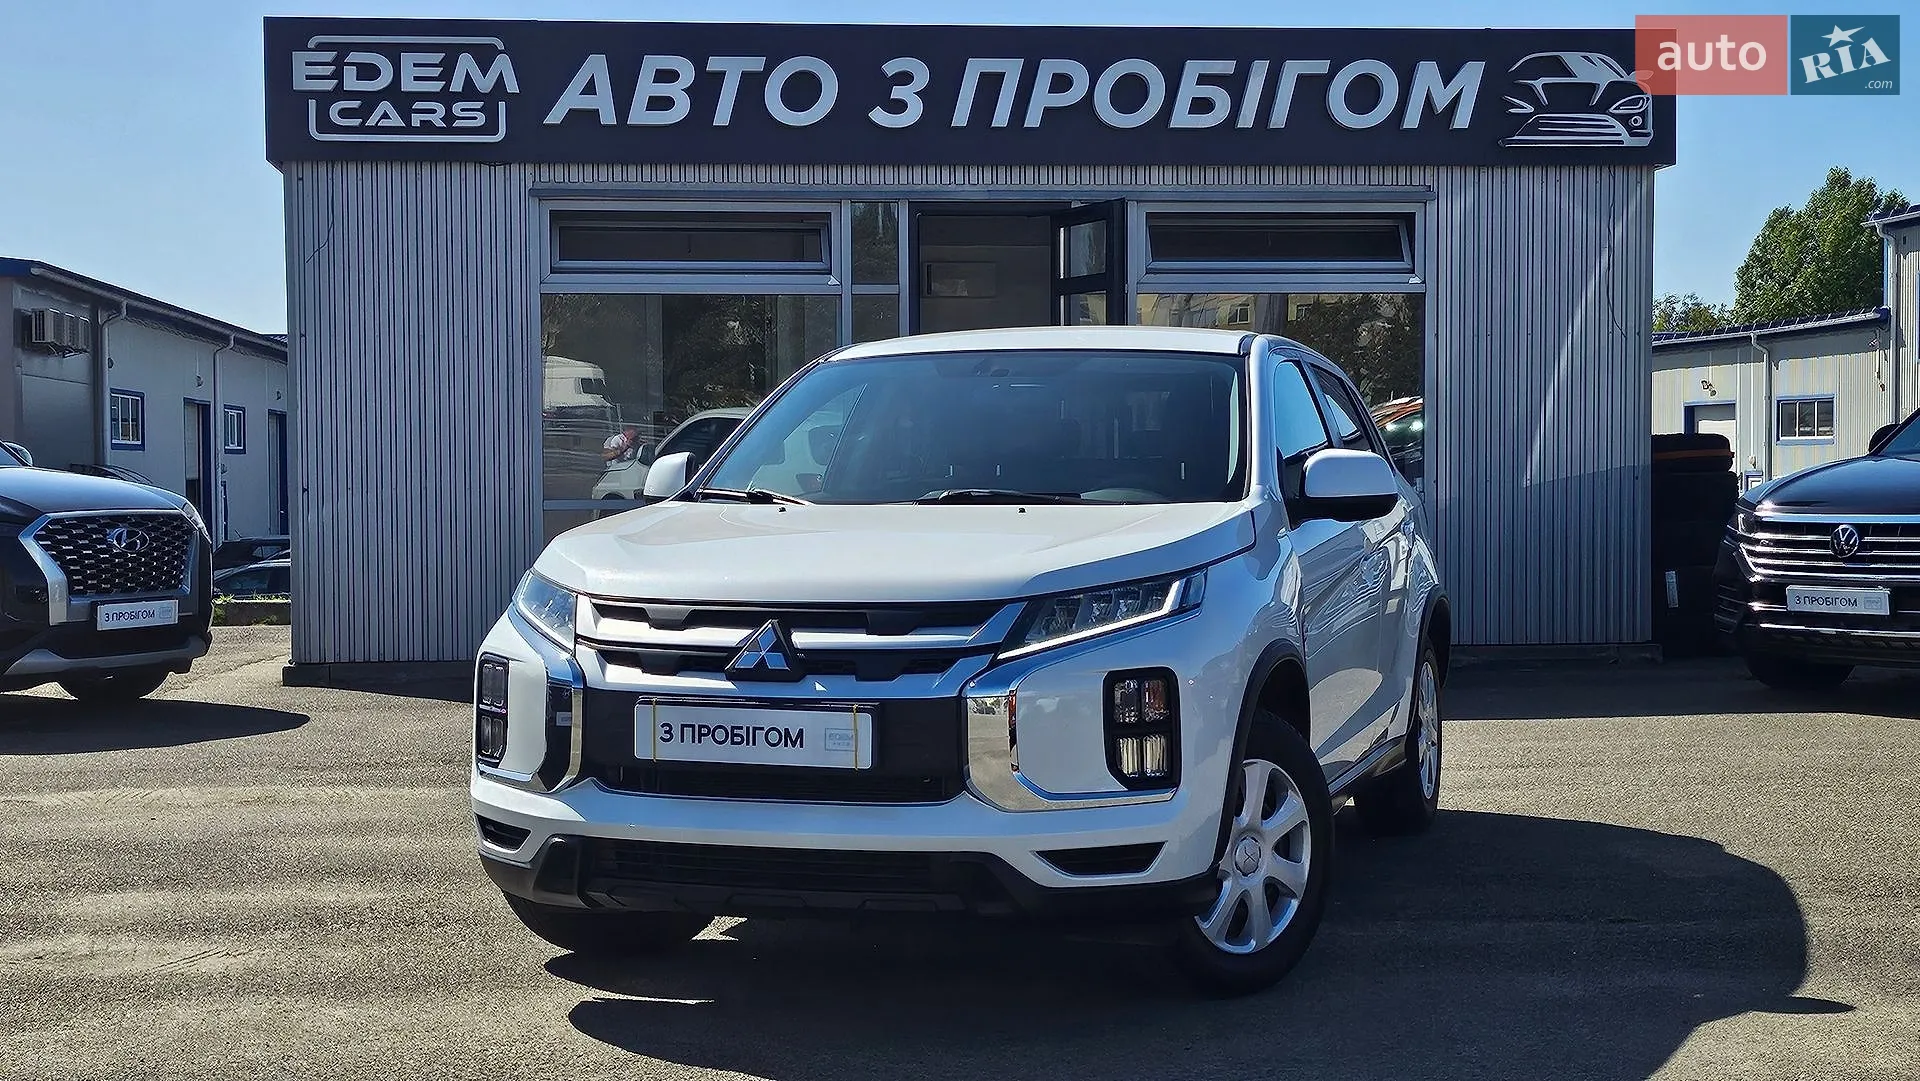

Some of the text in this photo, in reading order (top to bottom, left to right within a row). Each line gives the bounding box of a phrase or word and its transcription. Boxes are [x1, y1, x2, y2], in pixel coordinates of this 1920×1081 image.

[292, 51, 519, 93] EDEM
[543, 54, 1486, 130] АВТО З ПРОБІГОМ
[329, 100, 486, 127] CARS
[1803, 596, 1858, 607] ПРОБІГОМ
[112, 609, 155, 621] ПРОБІГОМ
[659, 723, 804, 749] З ПРОБІГОМ
